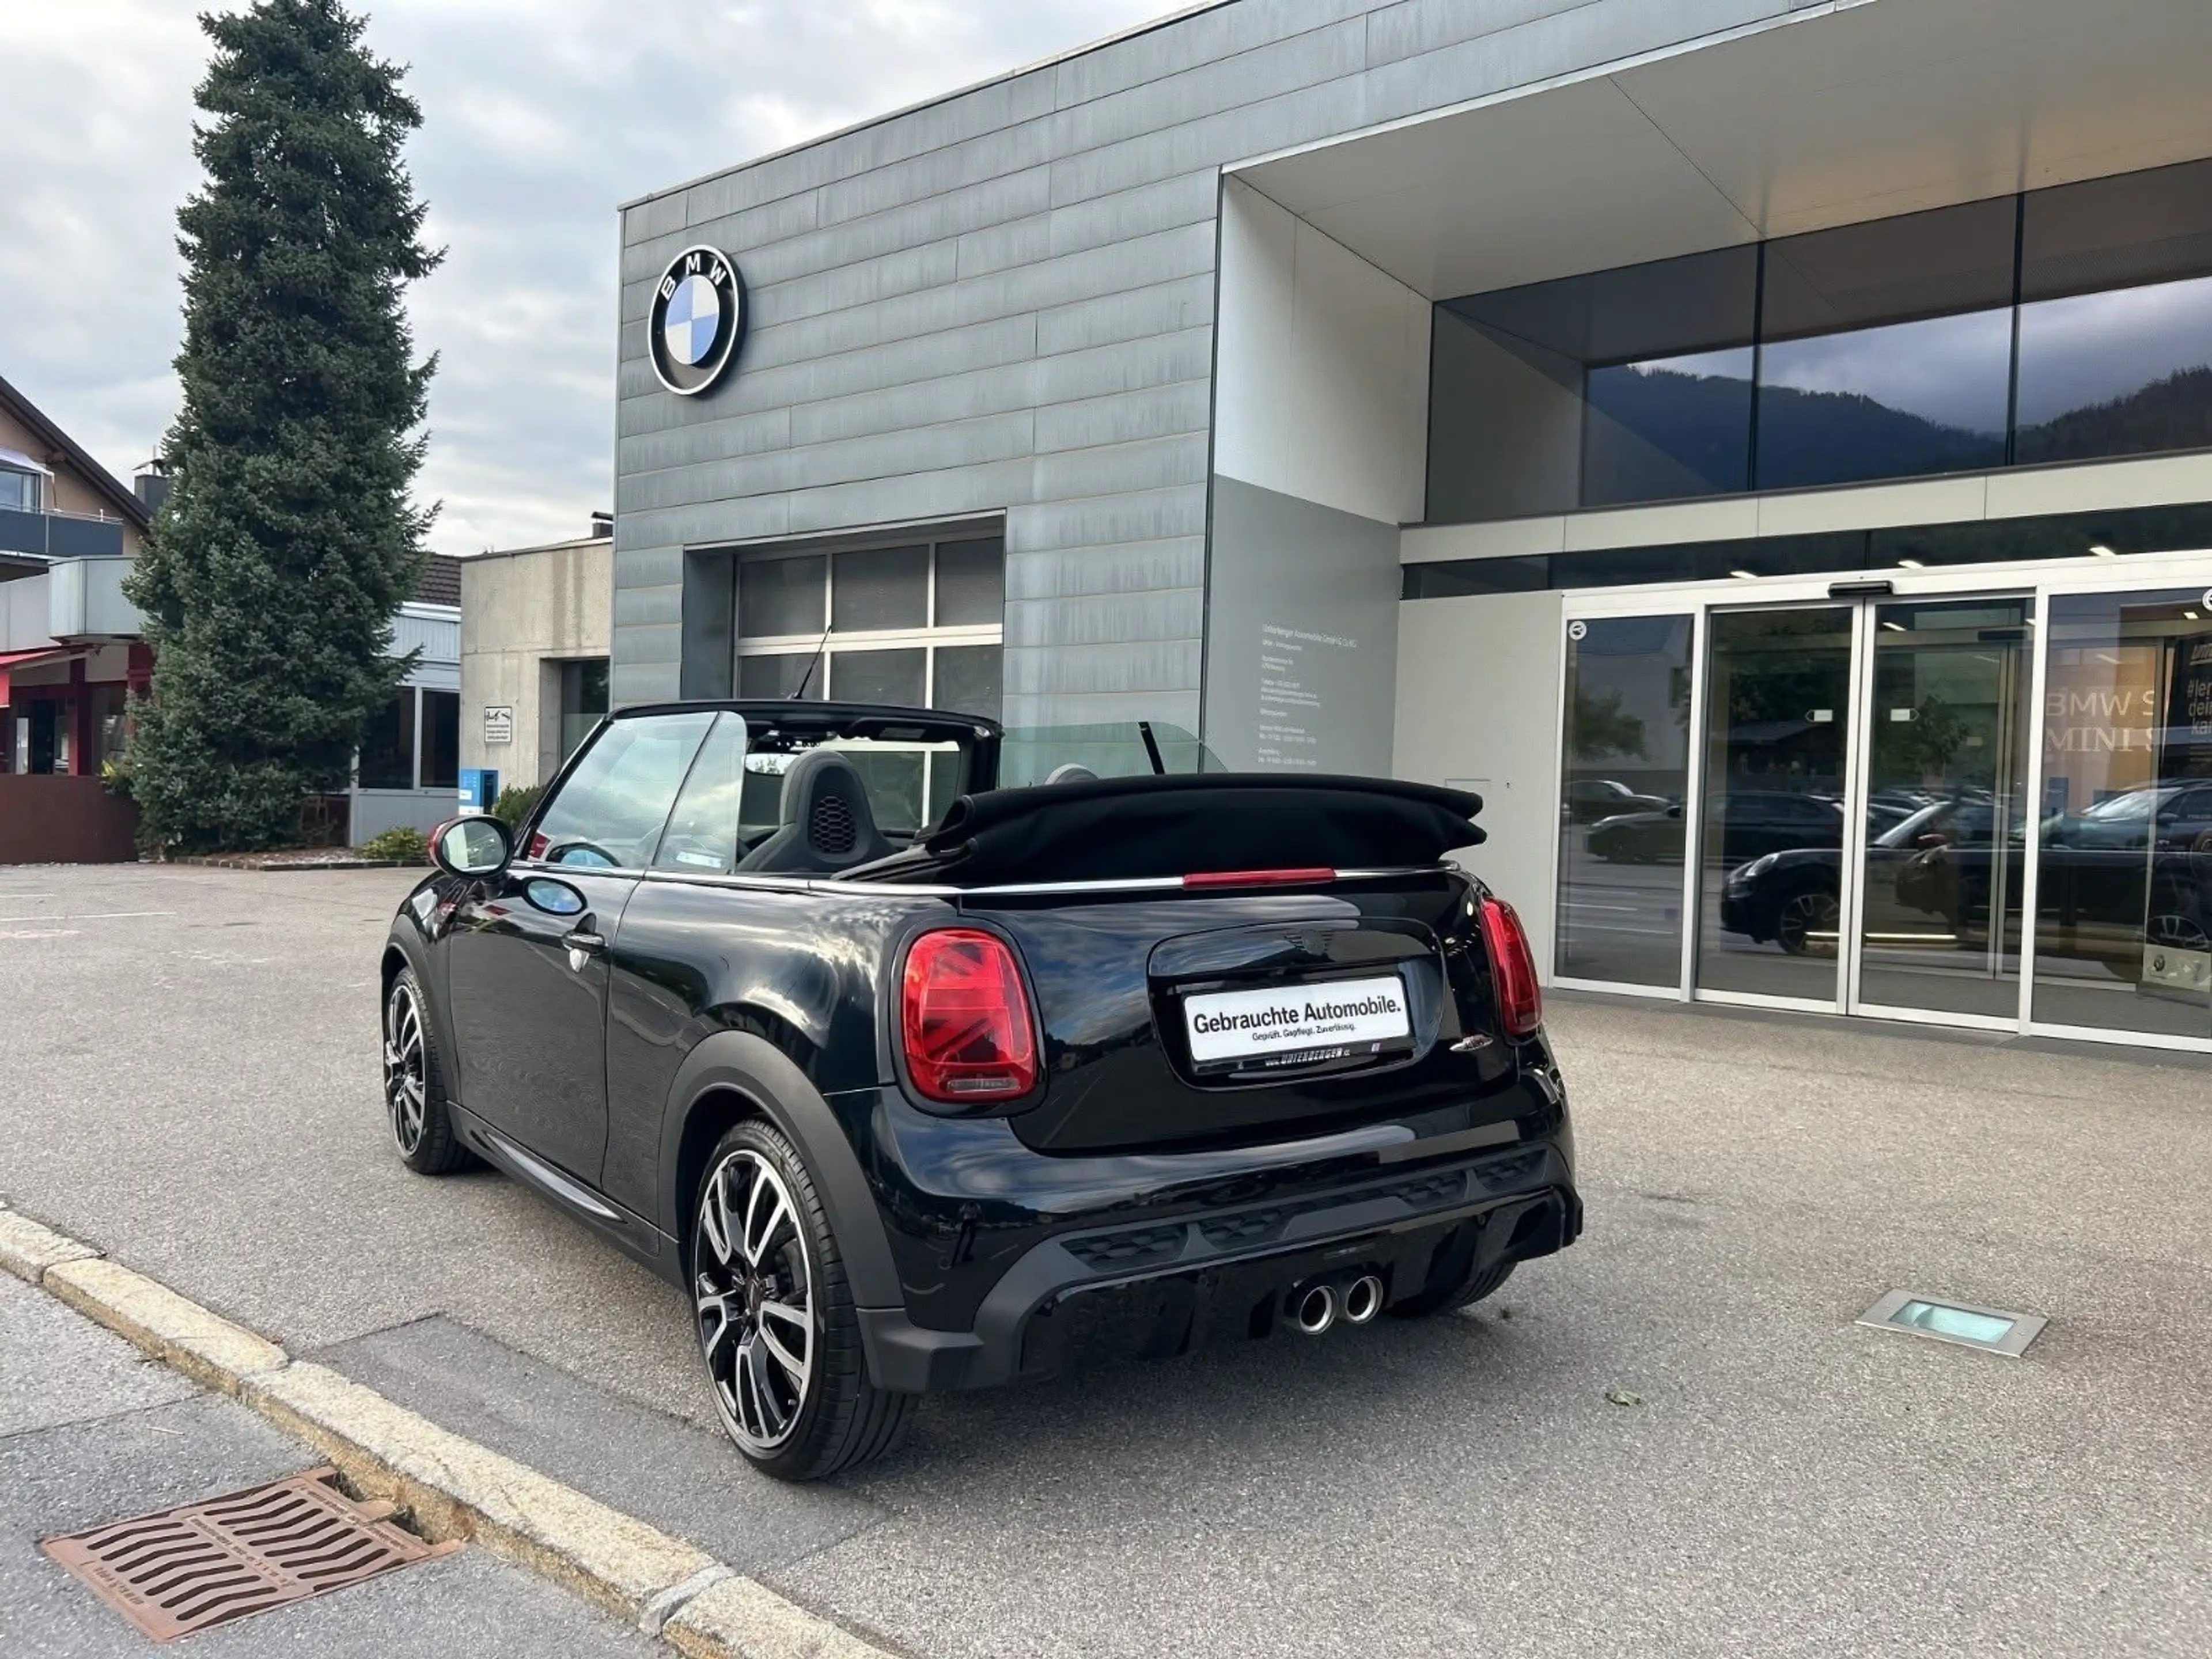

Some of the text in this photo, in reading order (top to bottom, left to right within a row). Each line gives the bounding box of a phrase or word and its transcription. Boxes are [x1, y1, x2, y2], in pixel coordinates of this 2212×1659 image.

[660, 252, 727, 301] BMW
[2046, 691, 2131, 716] BMW
[2046, 727, 2133, 752] MINI
[1194, 996, 1401, 1033] Gebrauchte Automobile.
